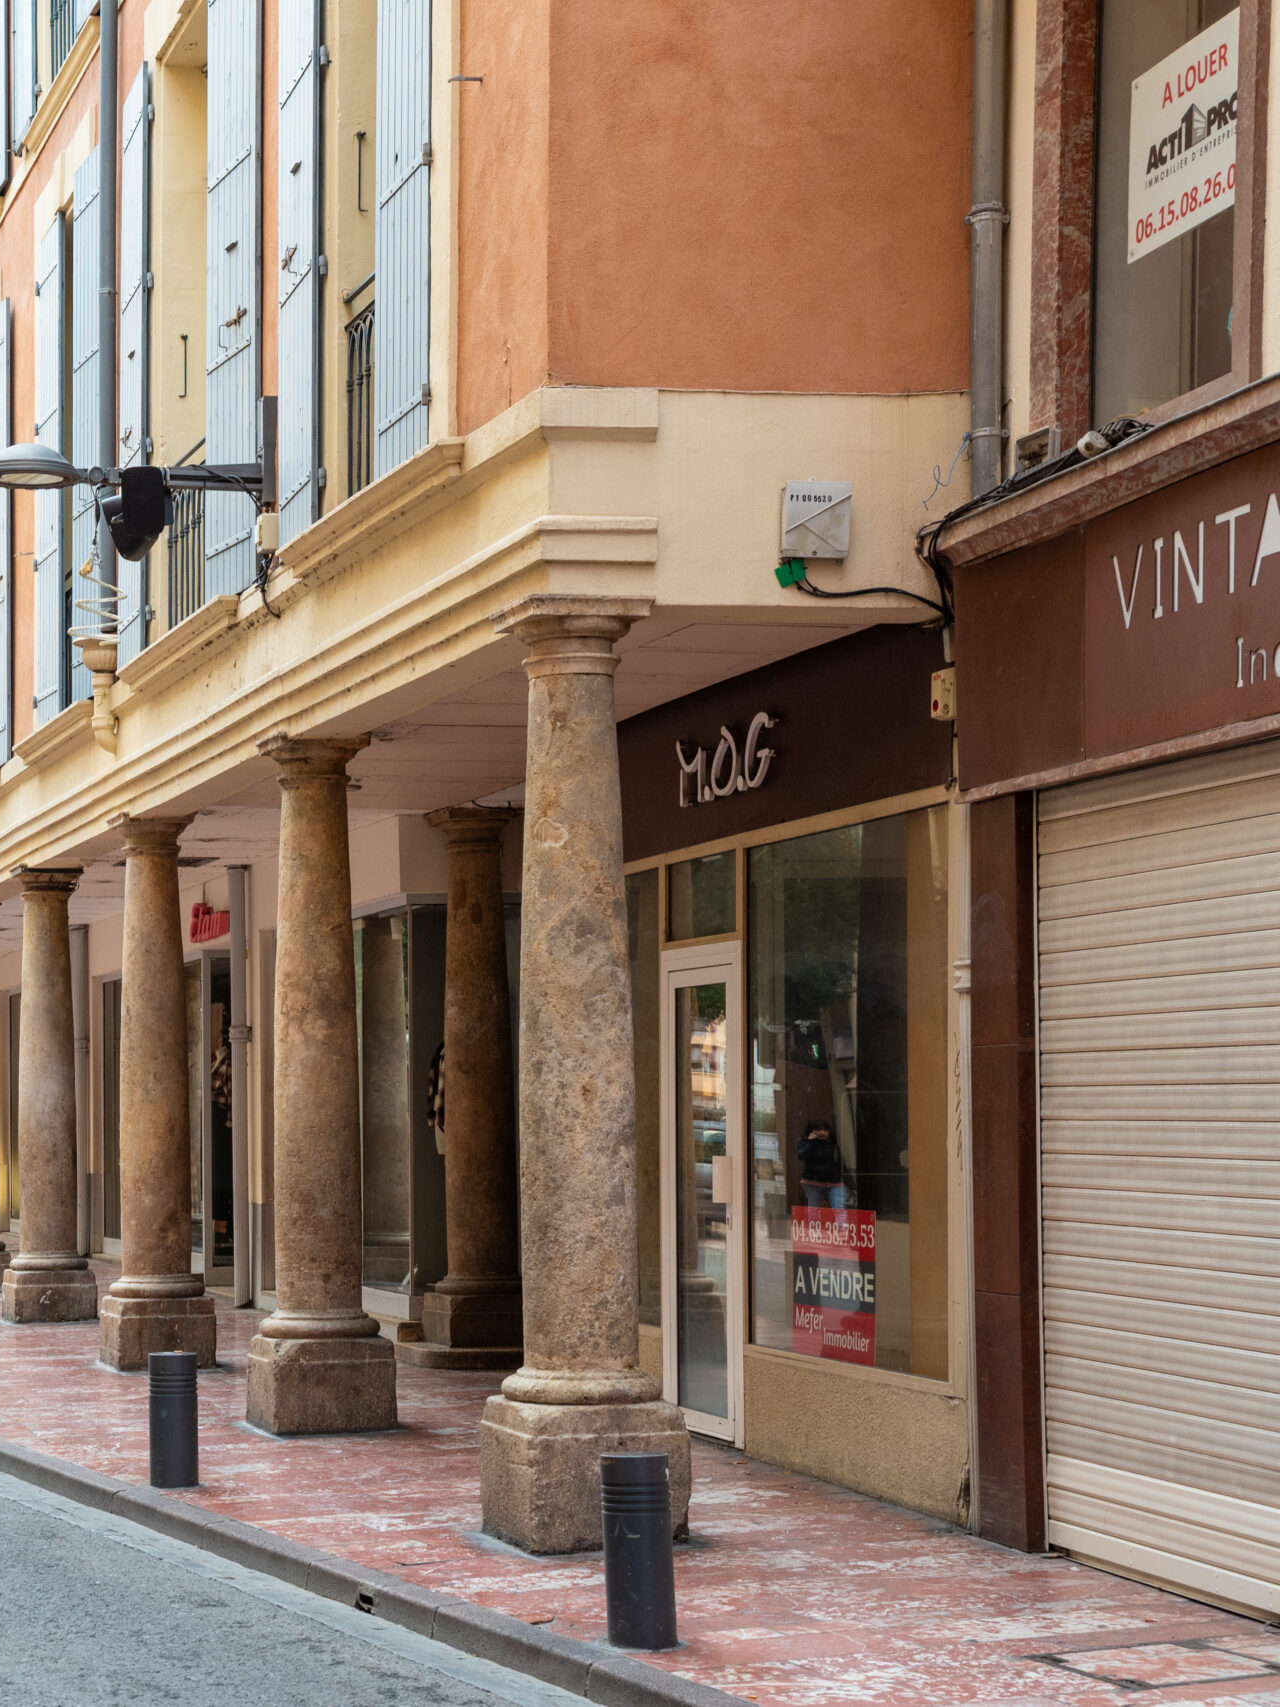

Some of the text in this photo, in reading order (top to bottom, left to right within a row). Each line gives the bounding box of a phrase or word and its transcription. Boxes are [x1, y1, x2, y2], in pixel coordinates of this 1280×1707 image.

[1162, 43, 1229, 109] A LOUER
[1145, 156, 1188, 190] IMMOBILIER
[1236, 636, 1280, 688] In
[792, 1218, 875, 1249] 04.68.38.73.53
[795, 1265, 875, 1303] A VENDRE
[795, 1305, 823, 1335] Mefer
[823, 1327, 870, 1353] Immobilier
